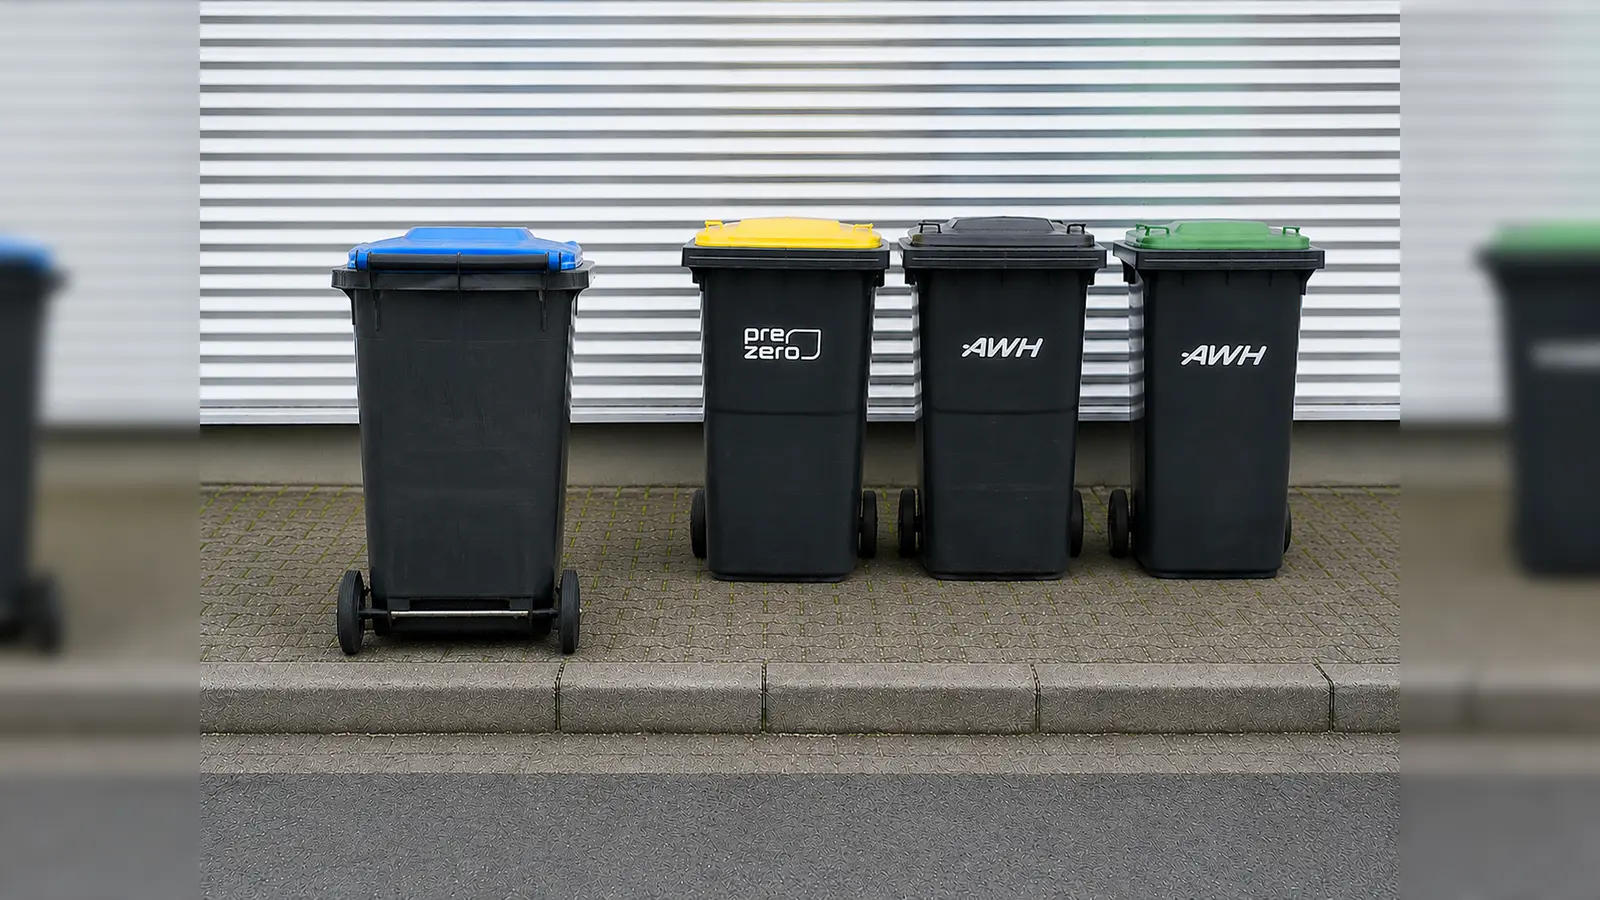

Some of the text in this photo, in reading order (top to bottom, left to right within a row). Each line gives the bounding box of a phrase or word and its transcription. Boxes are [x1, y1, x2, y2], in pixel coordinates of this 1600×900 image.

[744, 328, 785, 344] pre
[744, 345, 800, 360] zero
[962, 337, 1043, 358] AWH
[1181, 344, 1267, 366] AWH
